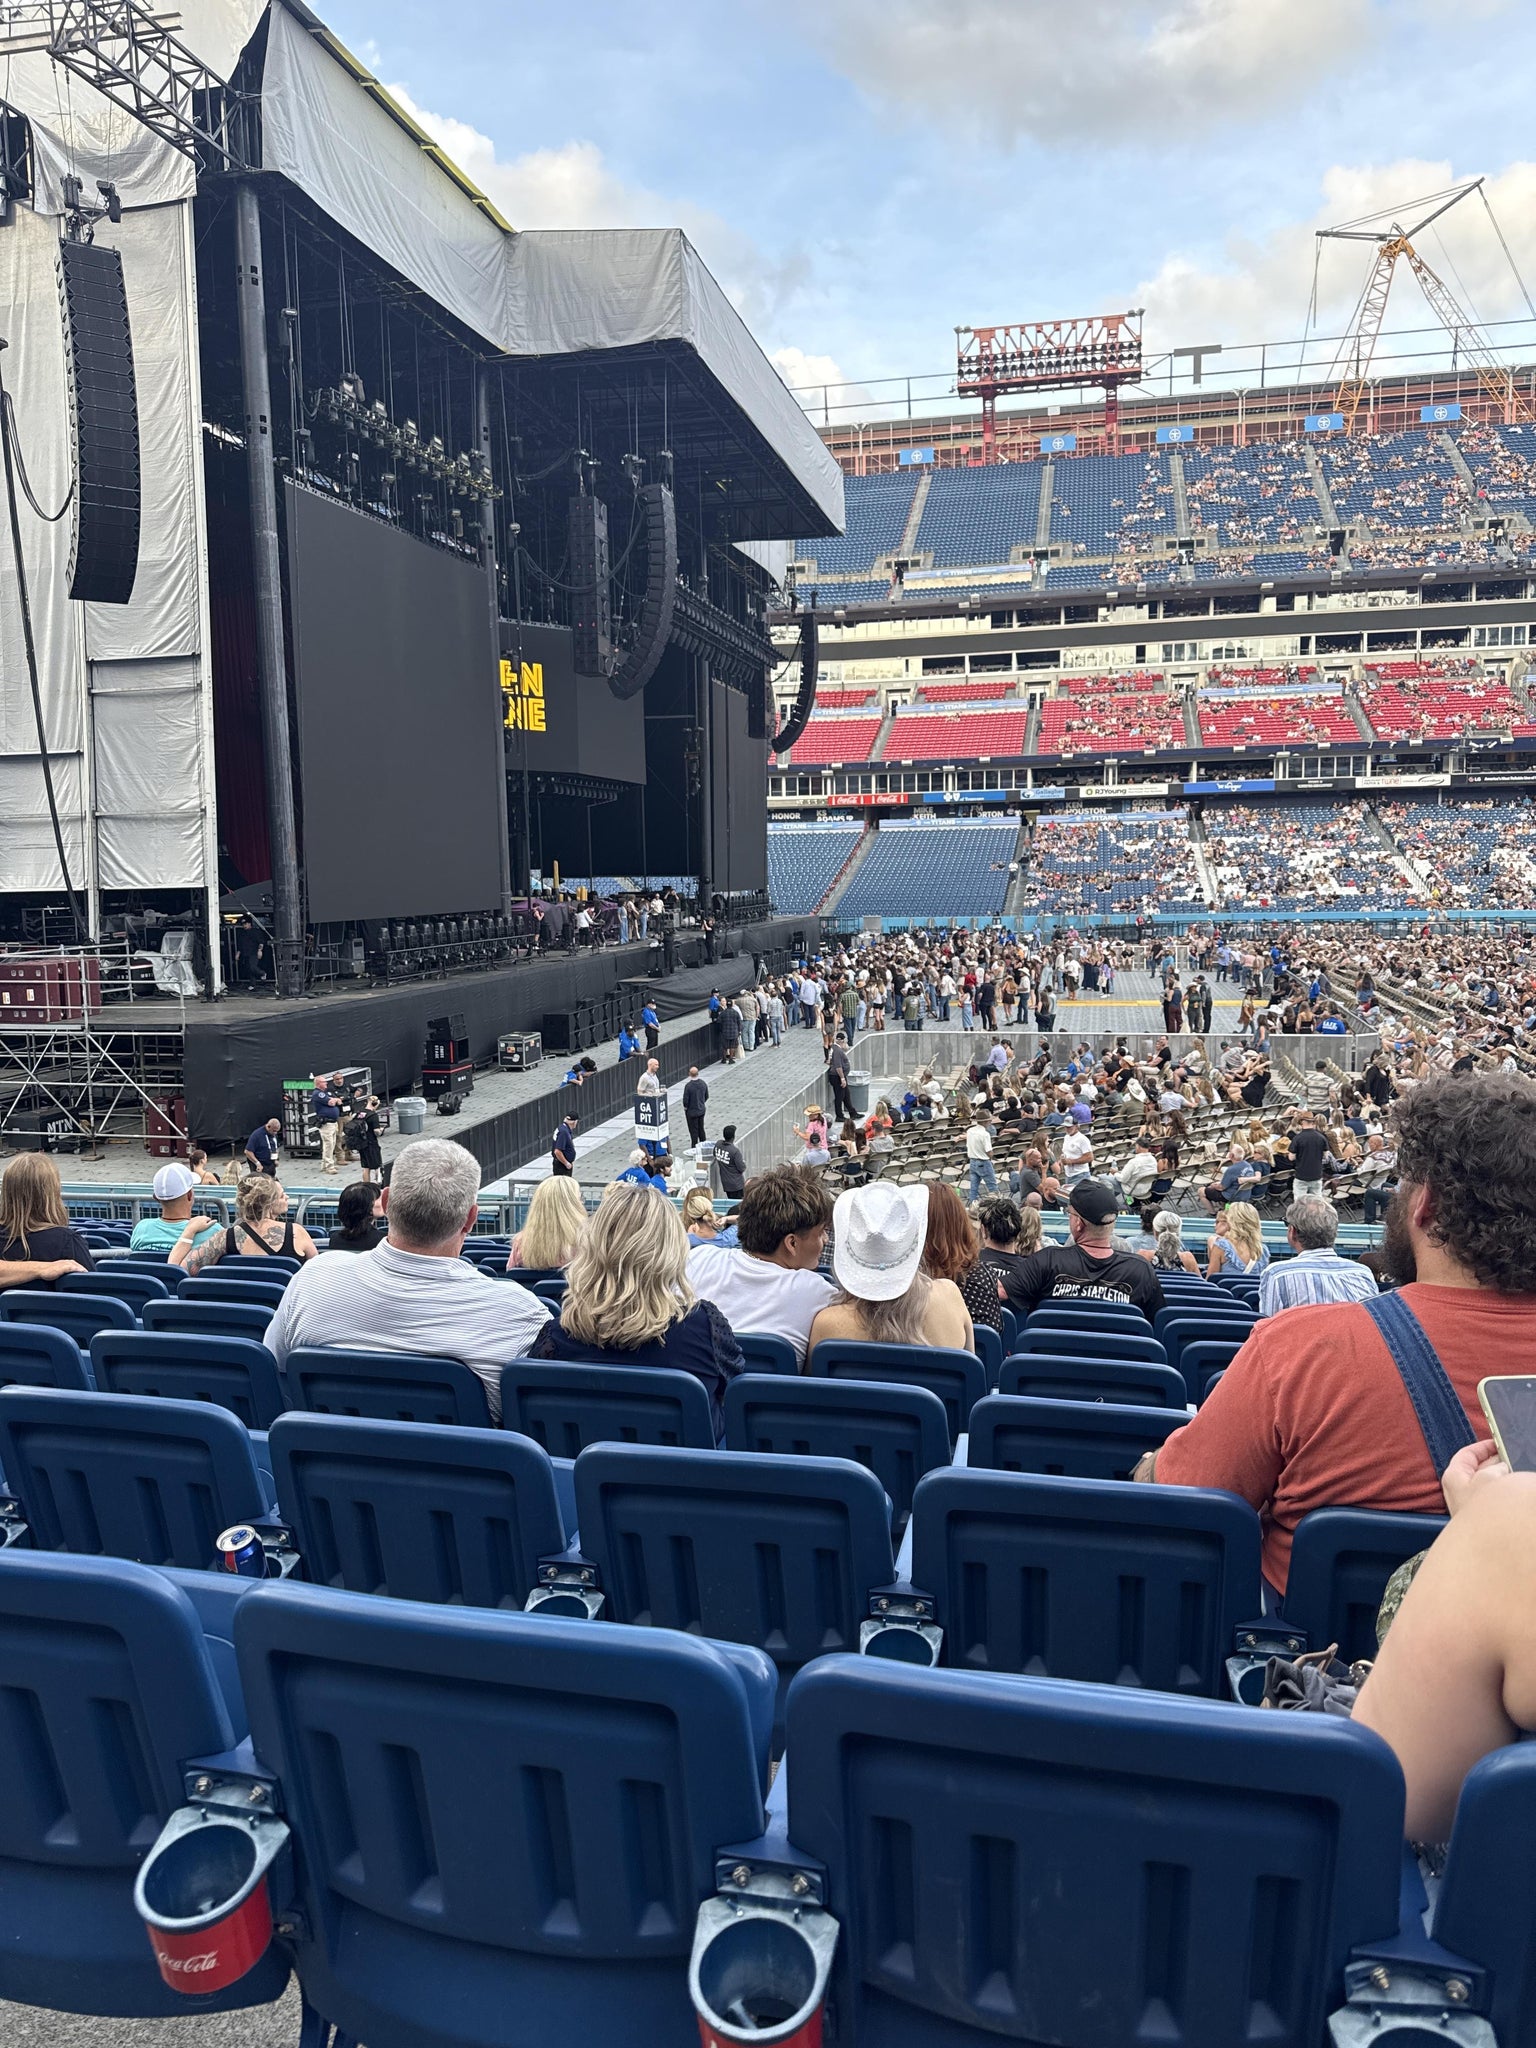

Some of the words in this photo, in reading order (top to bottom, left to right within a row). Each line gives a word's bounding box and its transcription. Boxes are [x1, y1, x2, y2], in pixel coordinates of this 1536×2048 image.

[1065, 801, 1083, 809] KEN
[1132, 798, 1166, 806] GEORGE
[1066, 807, 1106, 815] HOUSTON
[640, 1102, 652, 1113] GA
[640, 1112, 652, 1124] PIT
[1052, 1283, 1079, 1297] CHRIS
[1080, 1284, 1130, 1304] STAPLETON
[158, 1949, 220, 1973] Coca-Cola
